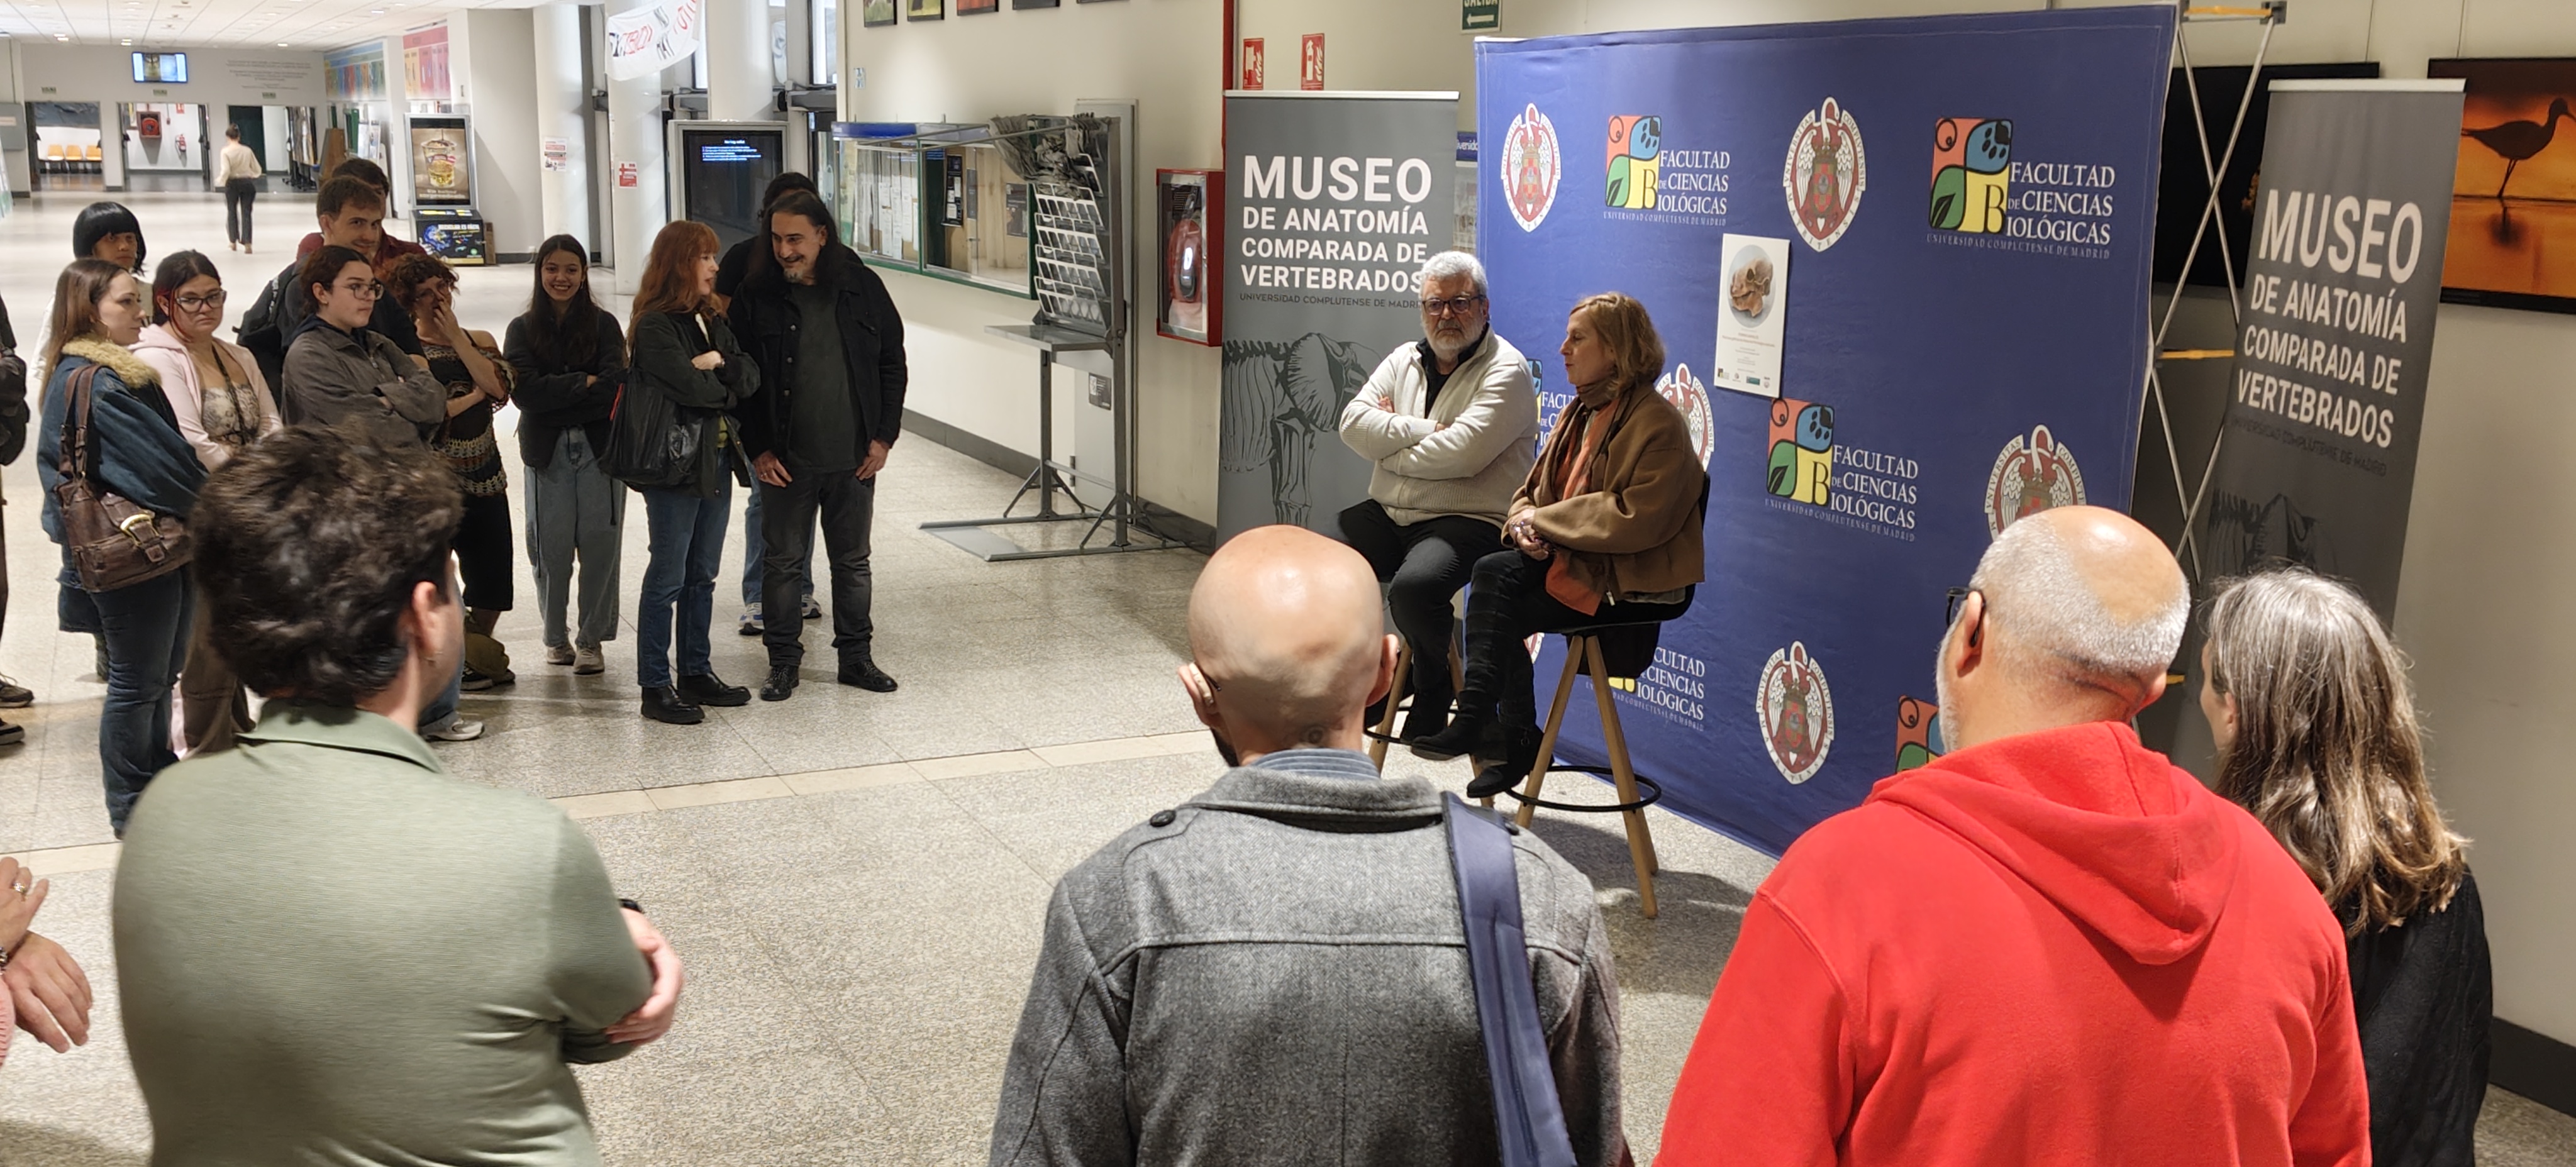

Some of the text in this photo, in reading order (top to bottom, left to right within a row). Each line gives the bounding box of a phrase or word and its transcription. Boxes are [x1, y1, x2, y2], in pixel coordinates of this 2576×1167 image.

[1659, 150, 1730, 169] FACULTAD
[2010, 162, 2115, 188] FACULTAD
[1243, 155, 1431, 202] MUSEO
[1658, 173, 1729, 192] DE CIENCIAS
[1604, 211, 1726, 226] UNIVERSIDAD COMPLUTENSE DE MADRID
[2008, 191, 2113, 216] DE CIENCIAS
[1243, 205, 1429, 235] DE ANATOMÍA
[1241, 237, 1427, 263] COMPARADA DE
[1926, 233, 2109, 259] UNIVERSIDAD COMPLUTENSE DE MADRID
[2258, 189, 2422, 283] MUSEO
[1241, 264, 1421, 293] VERTEBRADOS
[1240, 294, 1301, 303] UNIVERSIDAD
[1303, 296, 1371, 306] COMPLUTENSE
[1388, 300, 1420, 309] MADRI
[2251, 274, 2406, 343] DE ANATOMÍA
[2244, 324, 2402, 395] COMPARADA DE
[2238, 368, 2394, 448] VERTEBRADOS
[1833, 444, 1918, 479] FACULTAD
[1831, 472, 1917, 504] DE CIENCIAS
[1765, 499, 1915, 542] UNIVERSIDAD COMPLUTENSE DE MADRID
[1653, 646, 1705, 678] CULTAD
[1646, 665, 1704, 699] CIENCIAS
